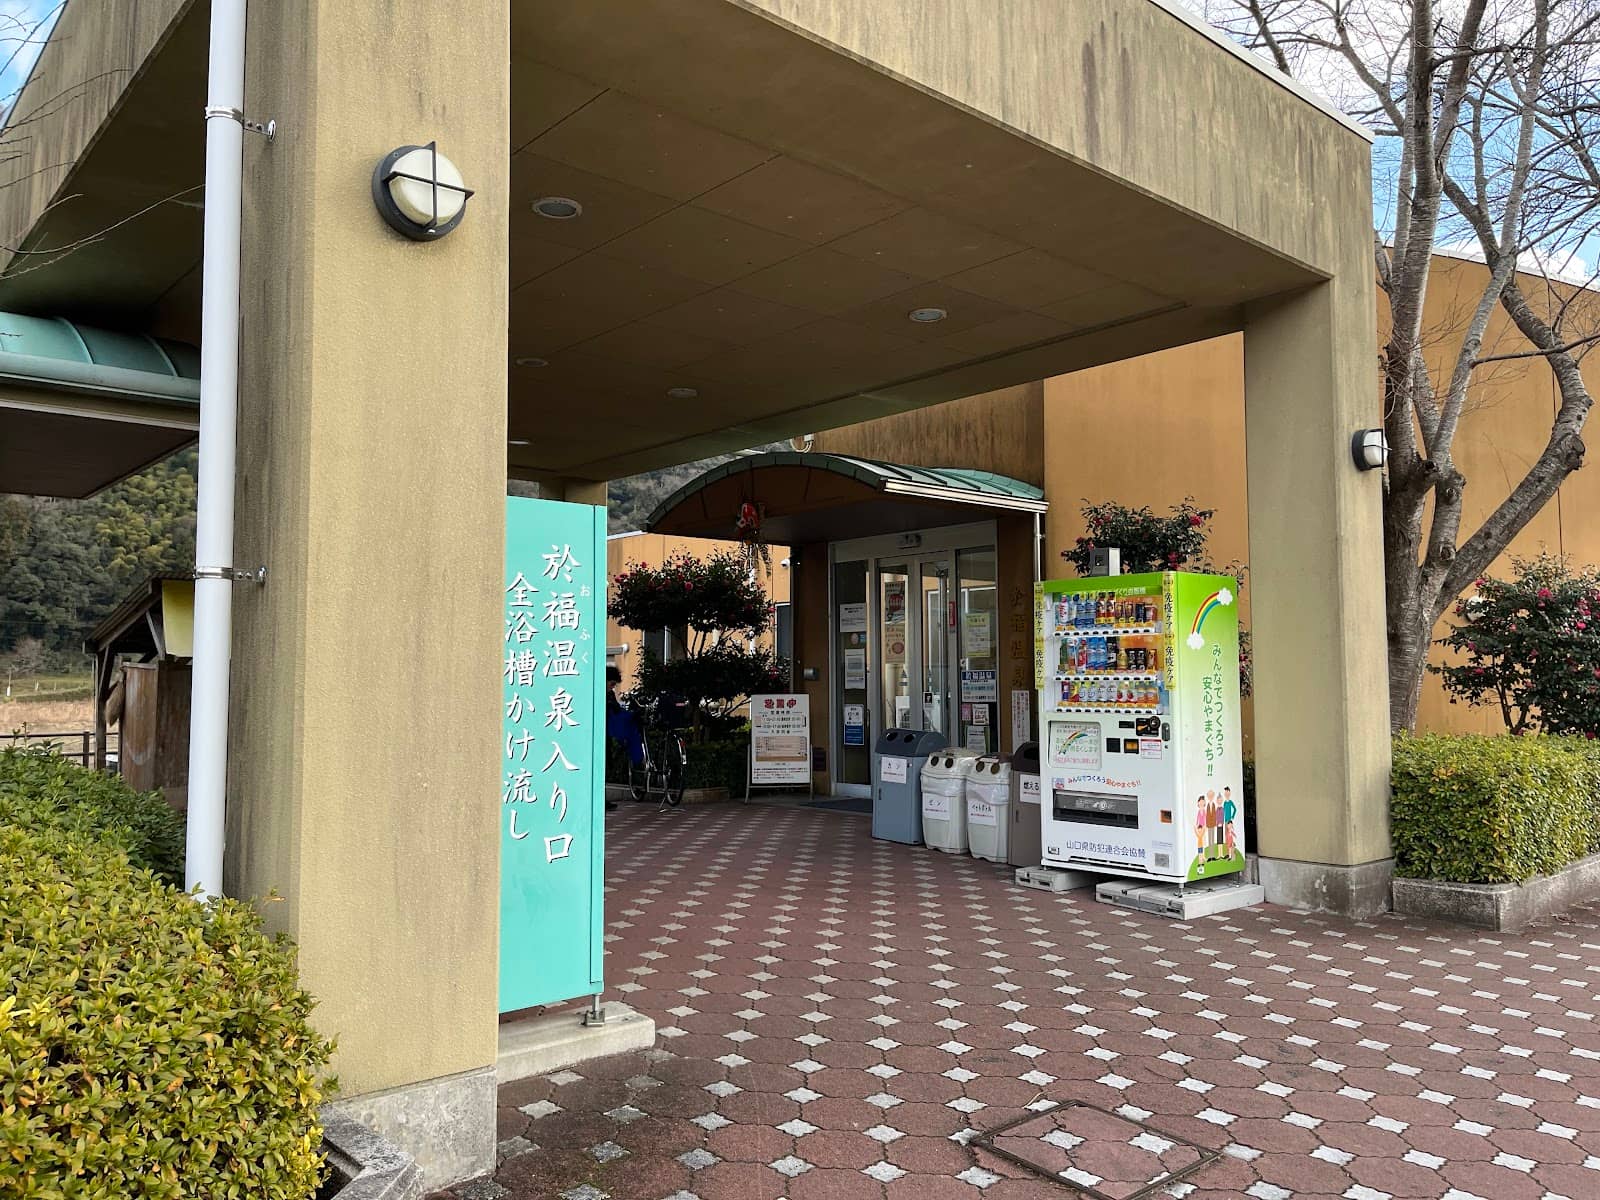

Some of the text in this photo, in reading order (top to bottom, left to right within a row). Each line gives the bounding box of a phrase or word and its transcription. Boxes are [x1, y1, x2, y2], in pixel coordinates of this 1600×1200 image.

[579, 584, 591, 664] おふく
[504, 571, 540, 840] 全浴槽かけ流し
[541, 543, 582, 864] 於福温泉入り口
[1212, 644, 1224, 757] みんなでつくろう
[1066, 840, 1146, 858] 山口県防犯連合会協賛
